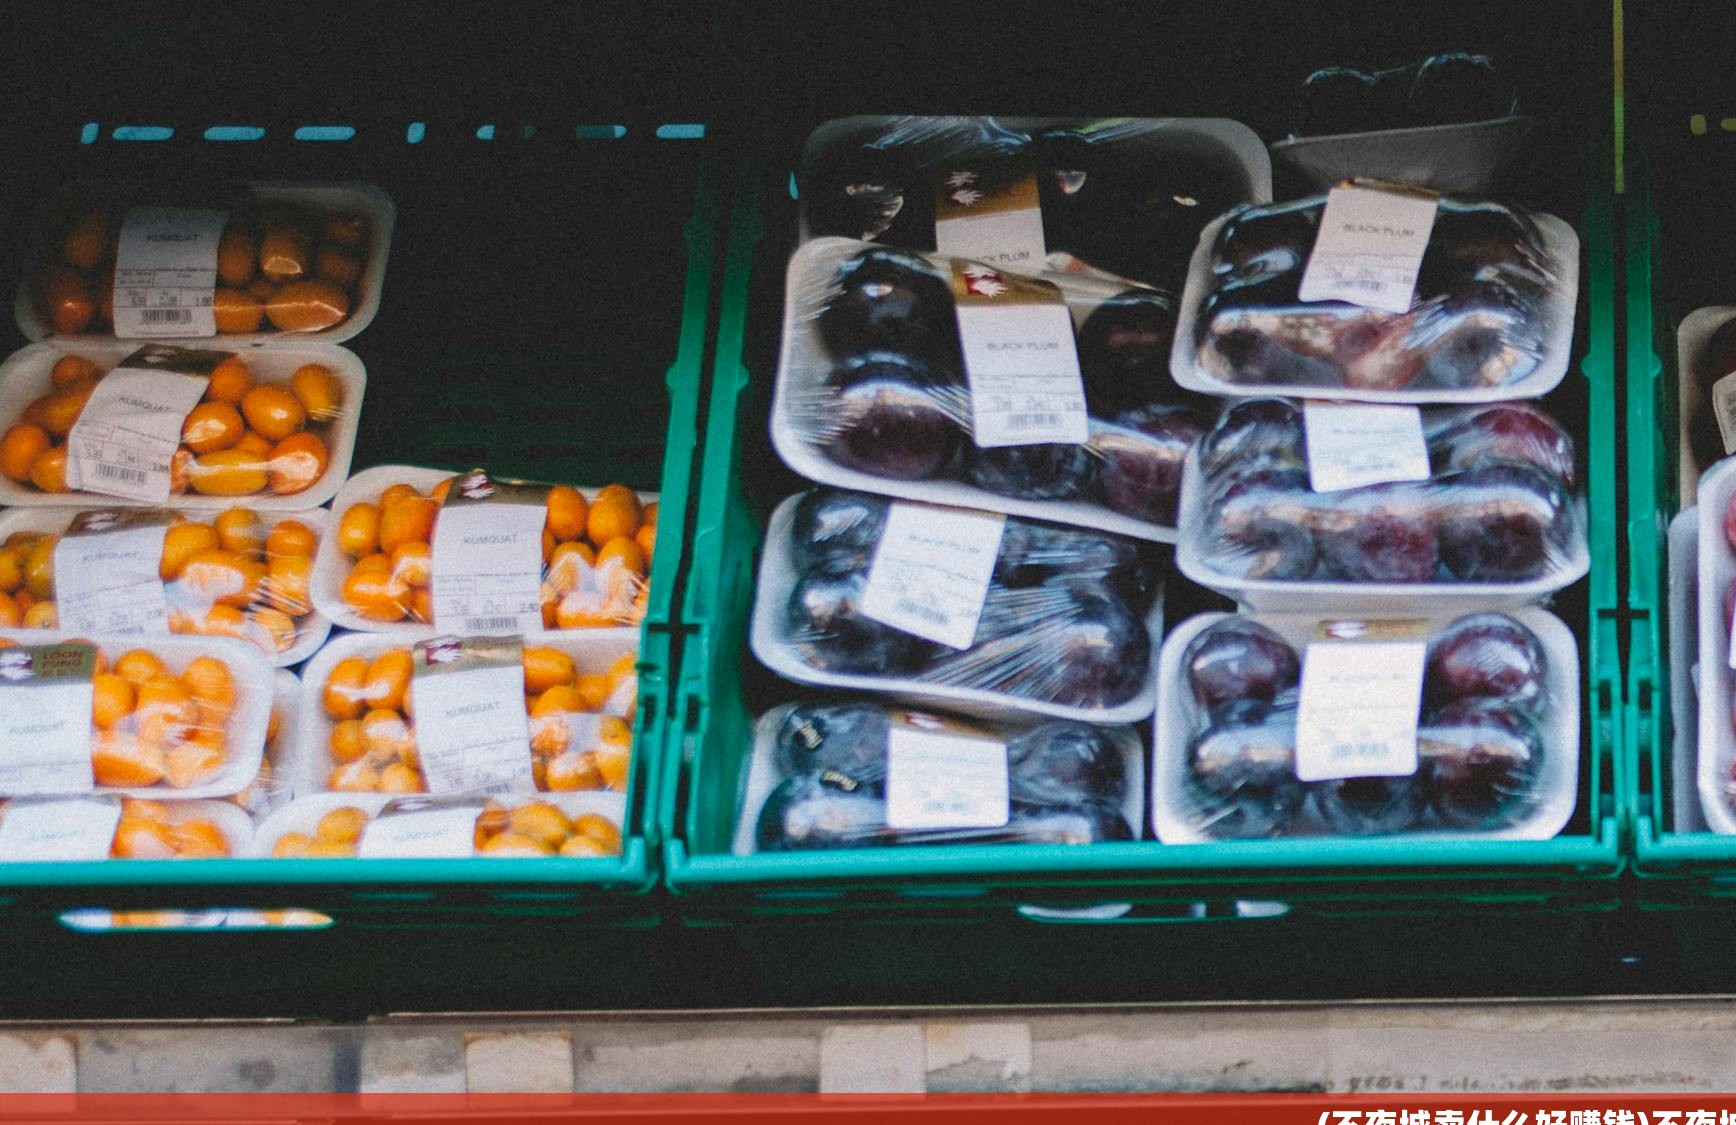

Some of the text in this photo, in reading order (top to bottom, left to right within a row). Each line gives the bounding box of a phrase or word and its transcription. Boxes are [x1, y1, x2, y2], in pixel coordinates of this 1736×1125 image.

[1343, 223, 1415, 237] BLACK PLUM
[146, 234, 198, 242] KUMQUAT
[1000, 250, 1030, 262] PLUM
[986, 342, 1059, 350] BLACK PLUM
[118, 396, 171, 412] KUMQUAT
[464, 534, 518, 544] KUMQUAT
[42, 650, 83, 660] LOON
[42, 659, 82, 668] FUNG
[446, 701, 500, 718] KUMQUAT
